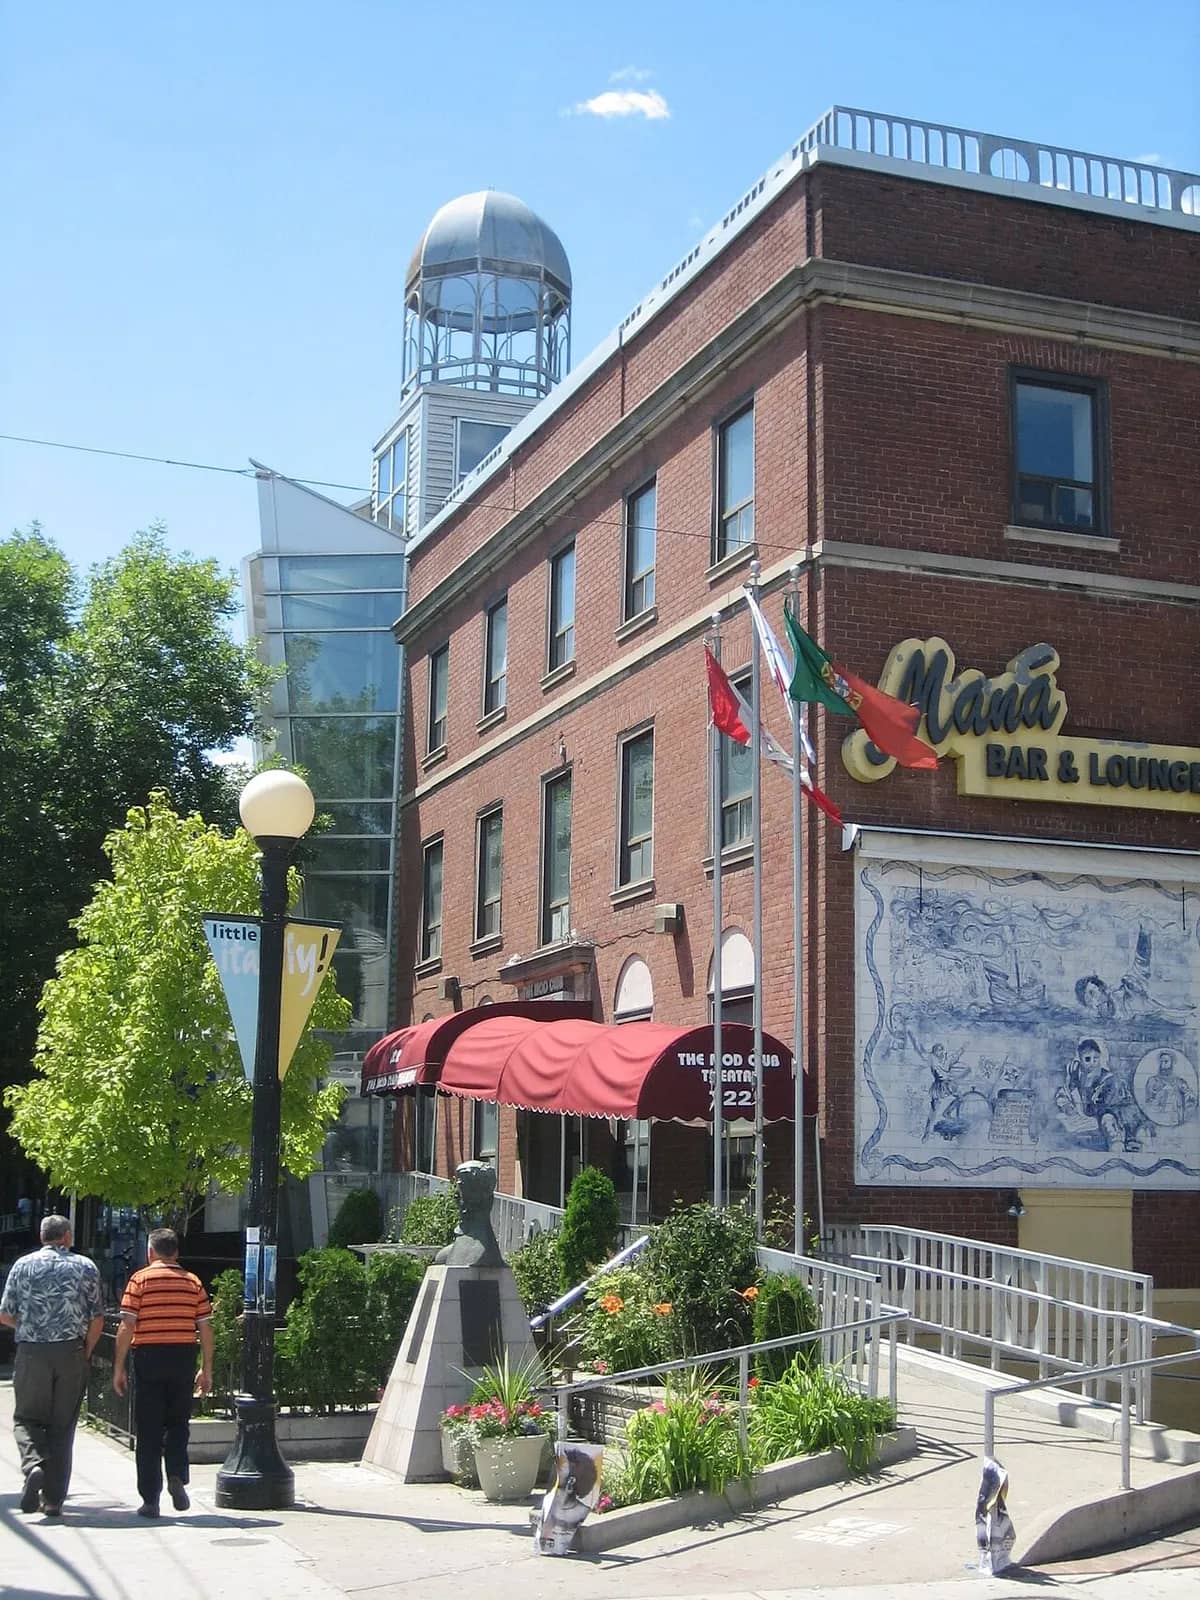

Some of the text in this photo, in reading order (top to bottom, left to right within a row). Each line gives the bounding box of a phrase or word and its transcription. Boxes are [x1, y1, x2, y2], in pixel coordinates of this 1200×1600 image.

[986, 743, 1200, 793] BAR & LOUNGE
[212, 924, 257, 941] little
[677, 1053, 704, 1066] THE
[747, 1054, 780, 1067] CUB
